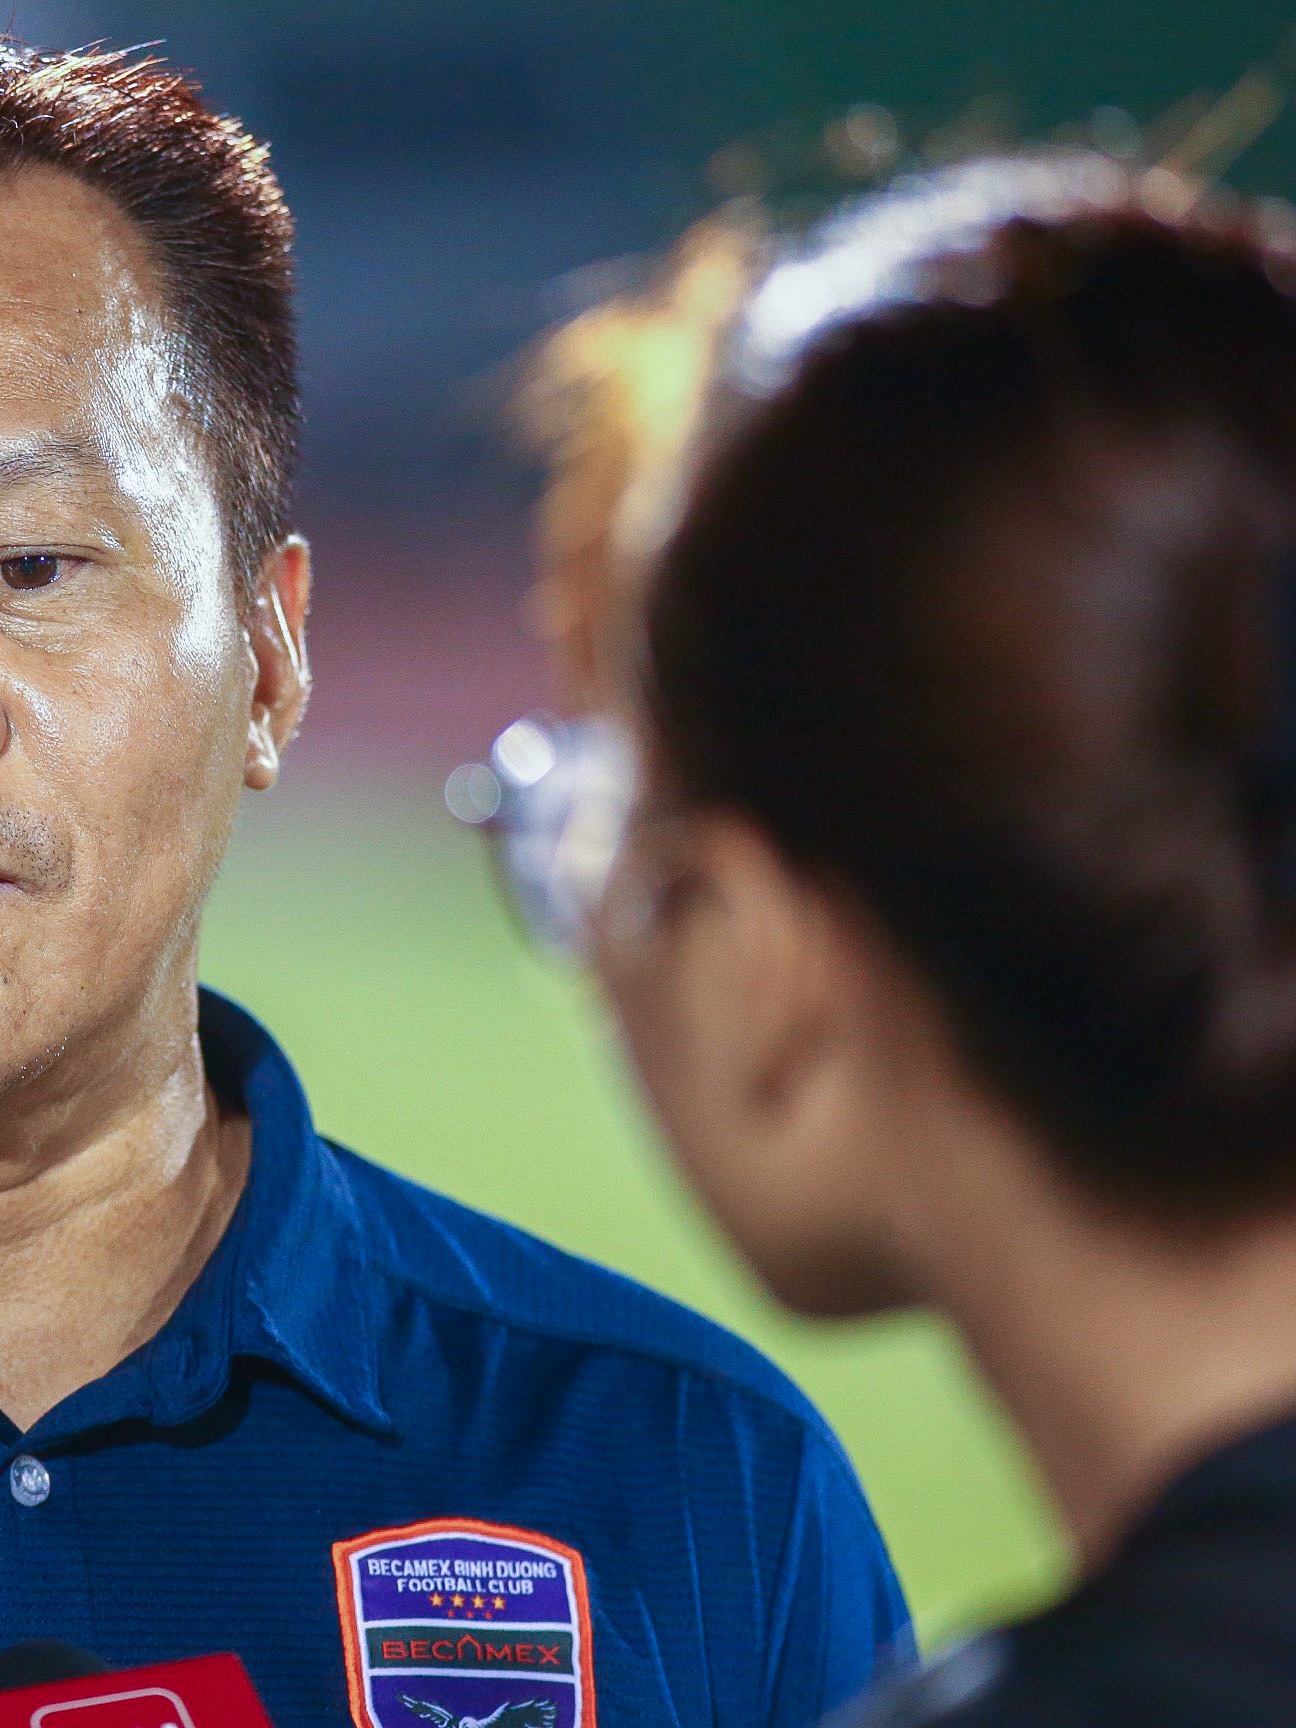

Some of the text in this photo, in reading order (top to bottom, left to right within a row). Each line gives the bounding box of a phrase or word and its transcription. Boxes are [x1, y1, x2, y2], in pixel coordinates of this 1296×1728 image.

[367, 1559, 557, 1579] BECAMEX BINH DUONG
[397, 1578, 534, 1595] FOOTBALL CLUB
